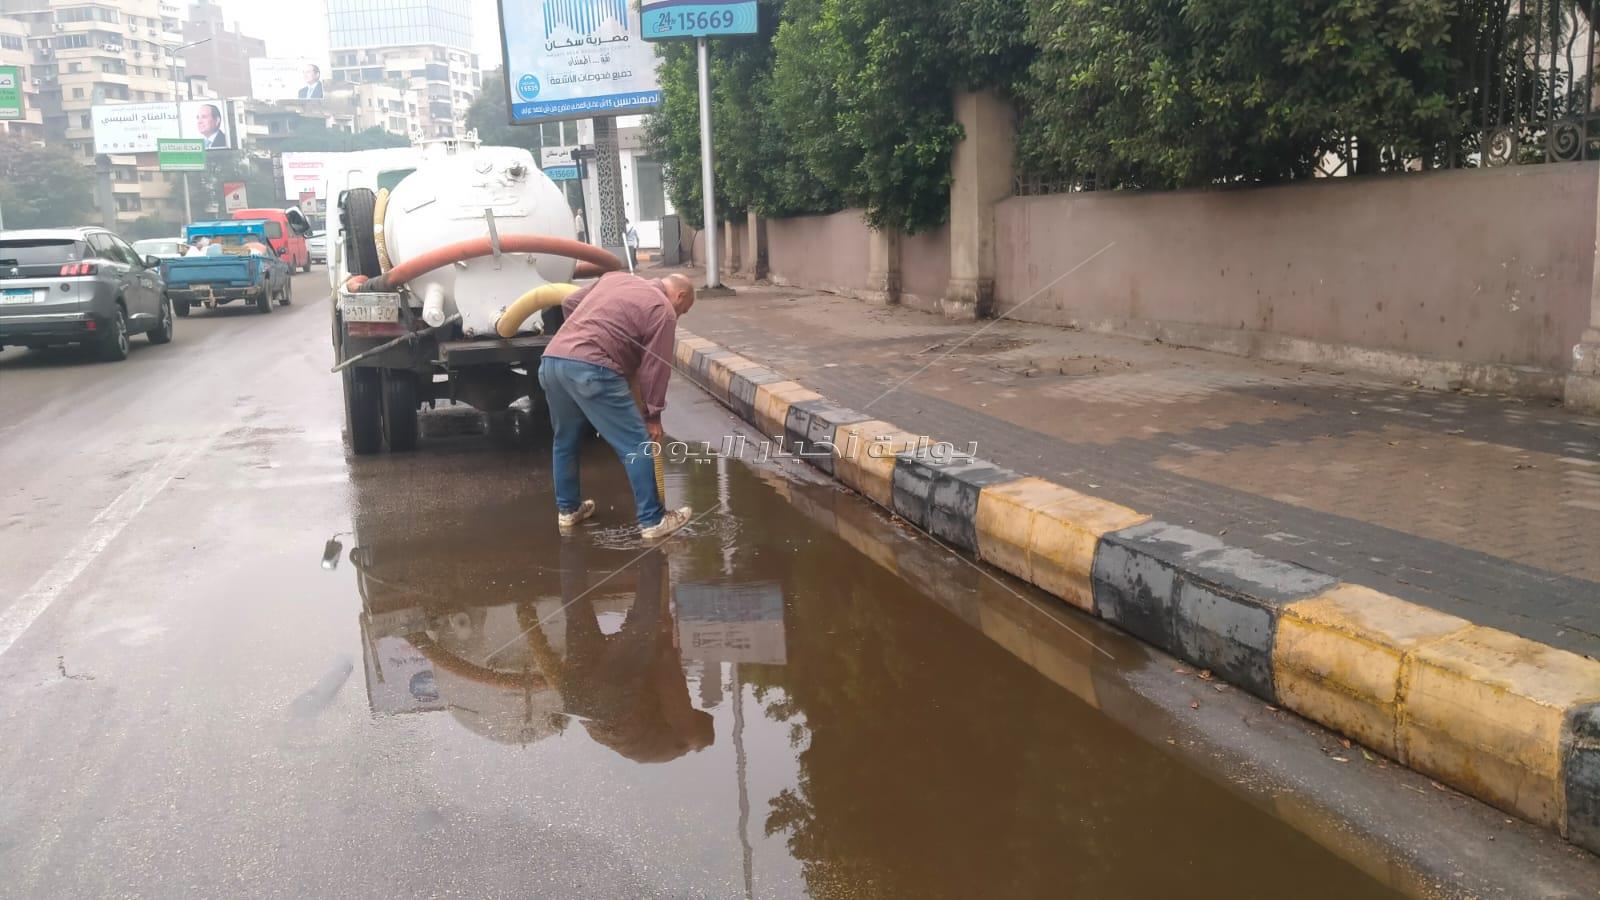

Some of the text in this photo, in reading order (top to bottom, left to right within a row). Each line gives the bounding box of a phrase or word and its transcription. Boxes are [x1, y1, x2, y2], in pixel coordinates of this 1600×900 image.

[678, 10, 734, 31] 15669
[545, 37, 584, 51] سكان
[586, 34, 629, 46] مصرية
[578, 71, 611, 82] فحوصات
[612, 70, 633, 81] جميع
[141, 112, 179, 124] بدالفتاح
